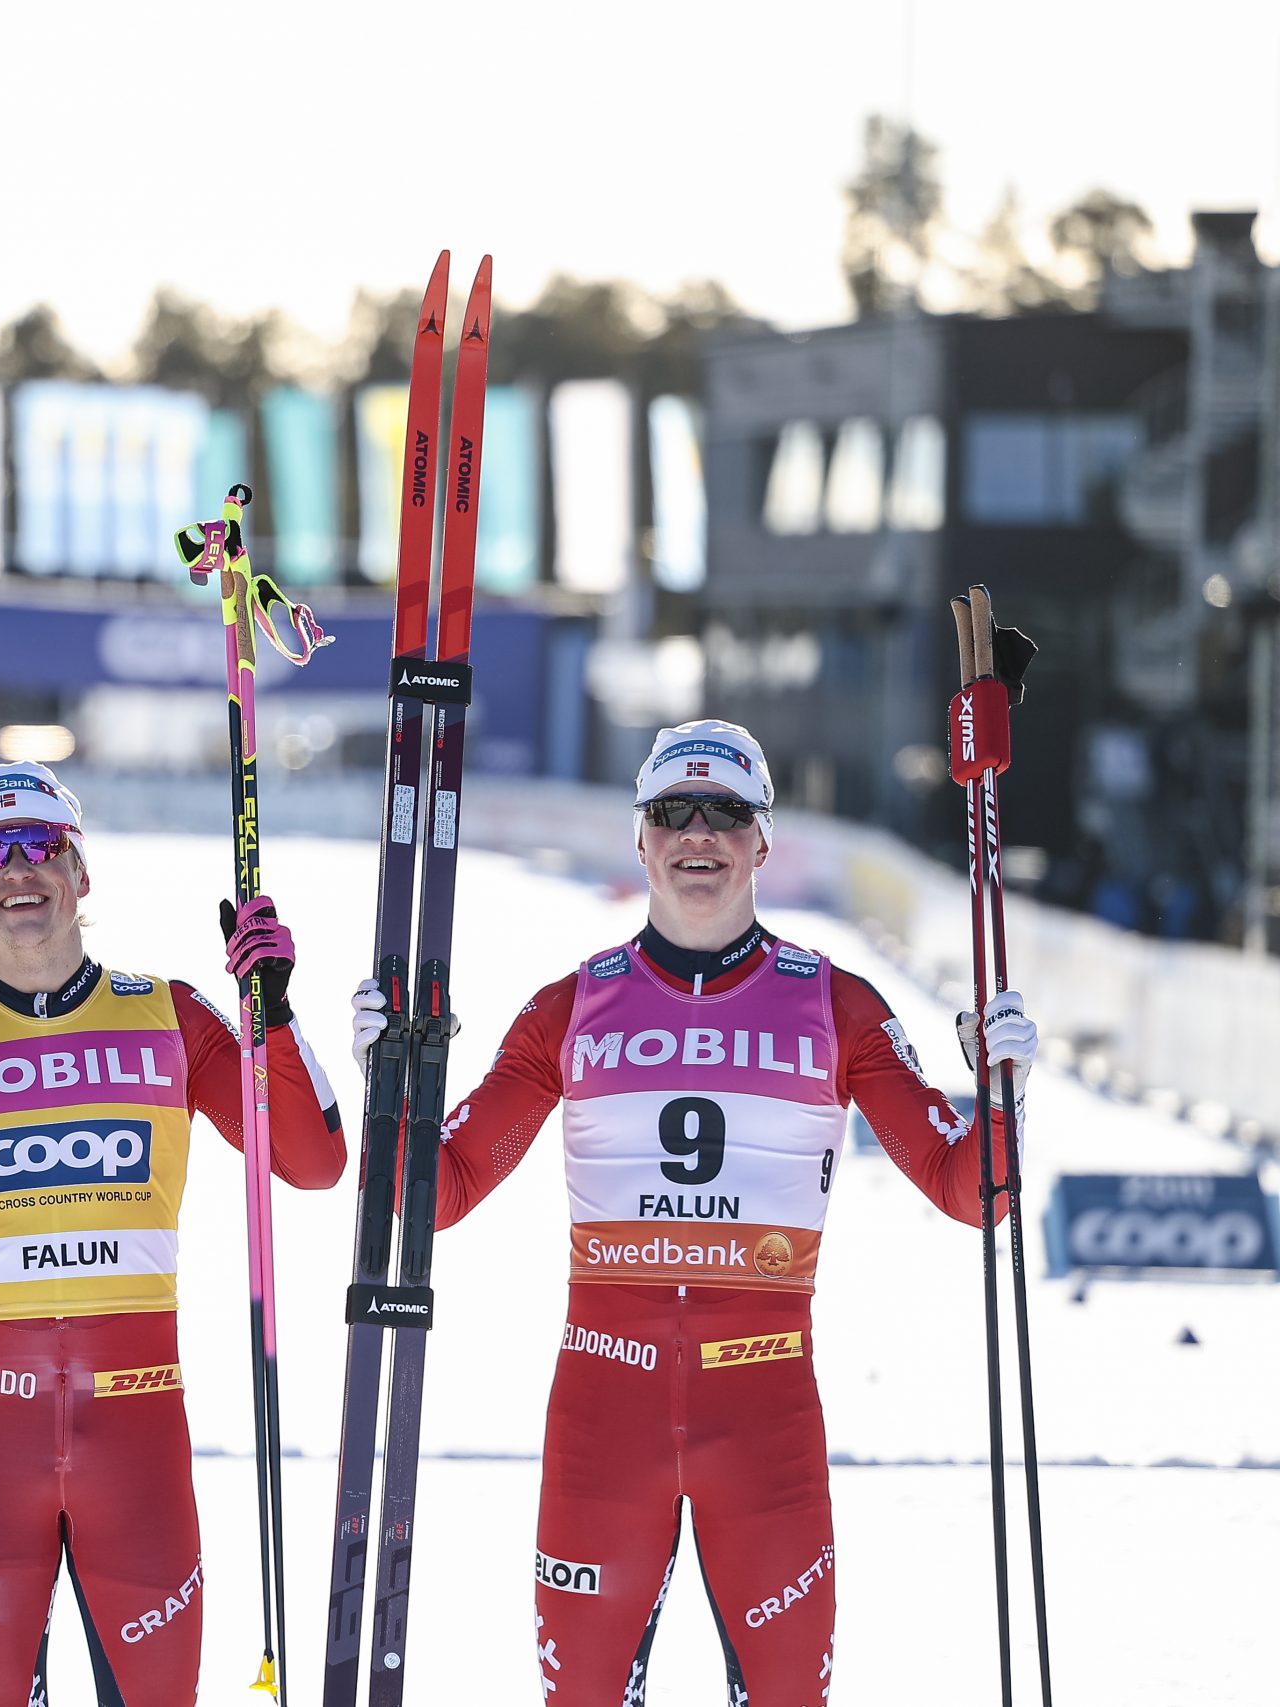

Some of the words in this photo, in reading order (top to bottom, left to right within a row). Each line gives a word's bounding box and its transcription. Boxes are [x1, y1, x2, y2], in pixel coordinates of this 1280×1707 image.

[412, 430, 429, 507] ATOMIC
[456, 436, 473, 514] ATOMIC
[204, 530, 221, 568] LEKI
[411, 676, 460, 688] ATOMIC
[654, 743, 734, 767] SpareBank
[244, 775, 257, 850] LEKI
[234, 917, 269, 940] HESTRA
[722, 938, 755, 966] CRAFT
[595, 968, 625, 977] coop
[777, 962, 816, 975] coop
[62, 971, 90, 1001] CRAFT
[571, 1028, 829, 1082] MOBILL
[658, 1097, 726, 1185] 9
[820, 1148, 834, 1194] 9
[39, 1193, 93, 1206] COUNTRY
[96, 1192, 132, 1202] WORLD
[135, 1191, 152, 1201] CUP
[639, 1194, 739, 1219] FALUN
[22, 1241, 119, 1269] FALUN
[586, 1238, 748, 1267] Swedbank
[380, 1304, 429, 1314] ATOMIC
[562, 1323, 657, 1371] ELDORADO
[717, 1337, 793, 1362] DHL
[109, 1369, 178, 1392] DHL
[120, 1565, 202, 1643] CRAFT
[745, 1559, 826, 1629] CRAFT
